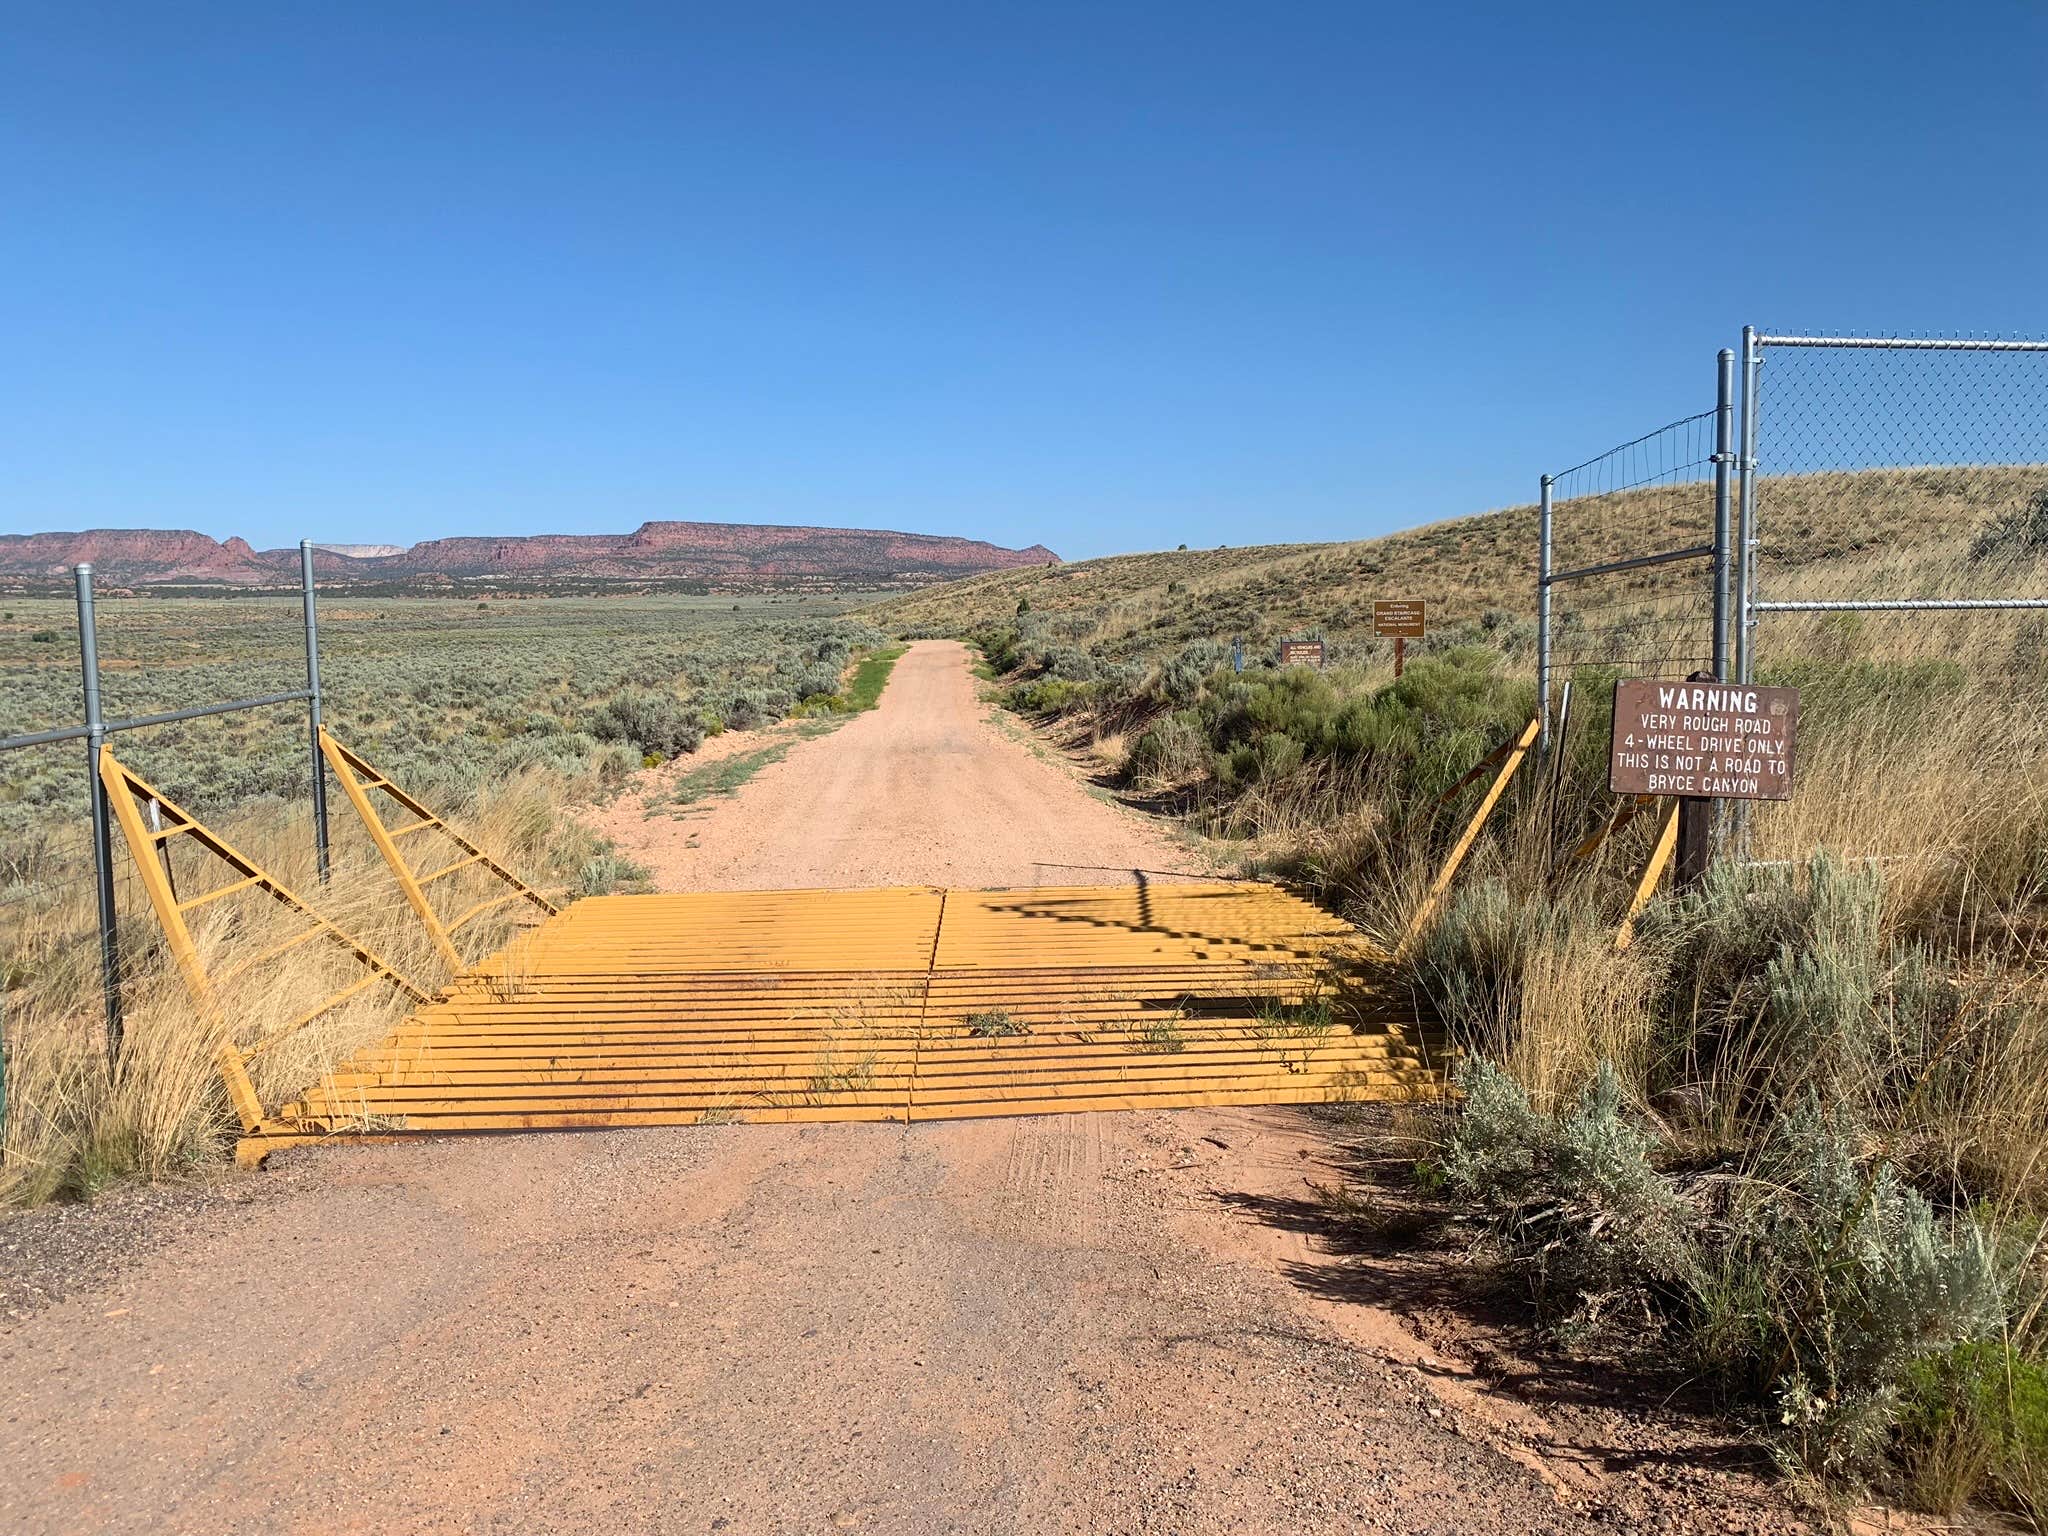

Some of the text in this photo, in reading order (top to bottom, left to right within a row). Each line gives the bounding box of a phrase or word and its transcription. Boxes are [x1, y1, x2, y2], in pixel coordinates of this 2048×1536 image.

[1659, 687, 1758, 713] WARNING
[1641, 714, 1771, 734] VERY ROUGH ROAD
[1700, 737, 1741, 753] DRIVE
[1617, 753, 1786, 775] THIS IS NOT A ROAD TO
[1648, 775, 1758, 794] BRYCE CANYON
